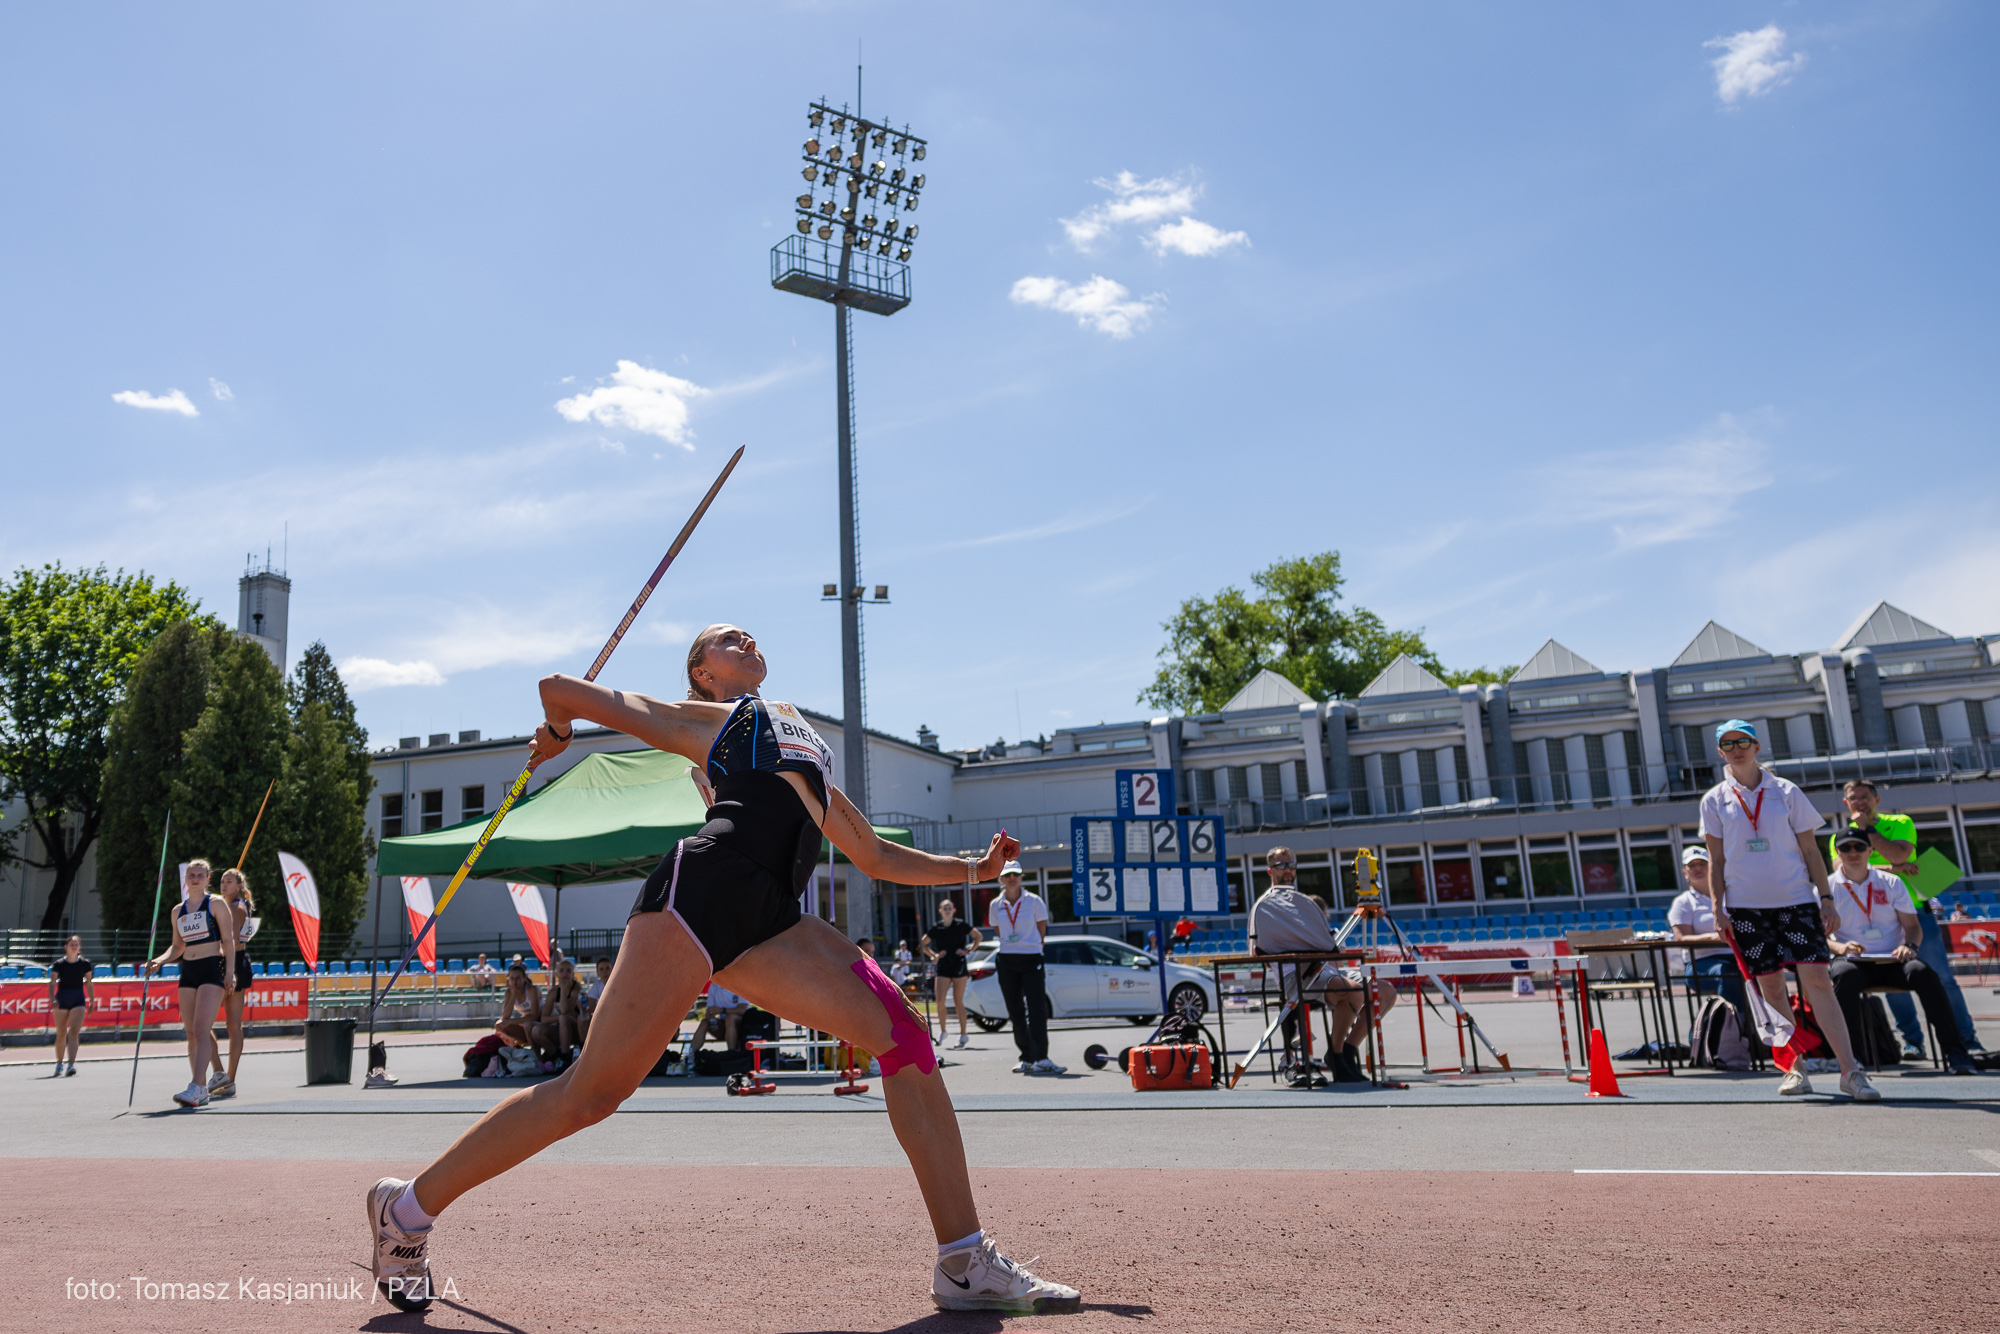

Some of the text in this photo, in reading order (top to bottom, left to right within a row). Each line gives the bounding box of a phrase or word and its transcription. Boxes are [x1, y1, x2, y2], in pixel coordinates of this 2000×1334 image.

[1120, 780, 1129, 808] ESSAI
[1135, 776, 1156, 806] 2
[1075, 828, 1085, 906] DOSSARD PERF
[1092, 871, 1113, 902] 3
[193, 912, 203, 921] 25
[183, 923, 200, 933] BAAS
[1521, 980, 1530, 992] 5
[243, 991, 299, 1008] RLEN
[389, 1241, 426, 1260] NIKE
